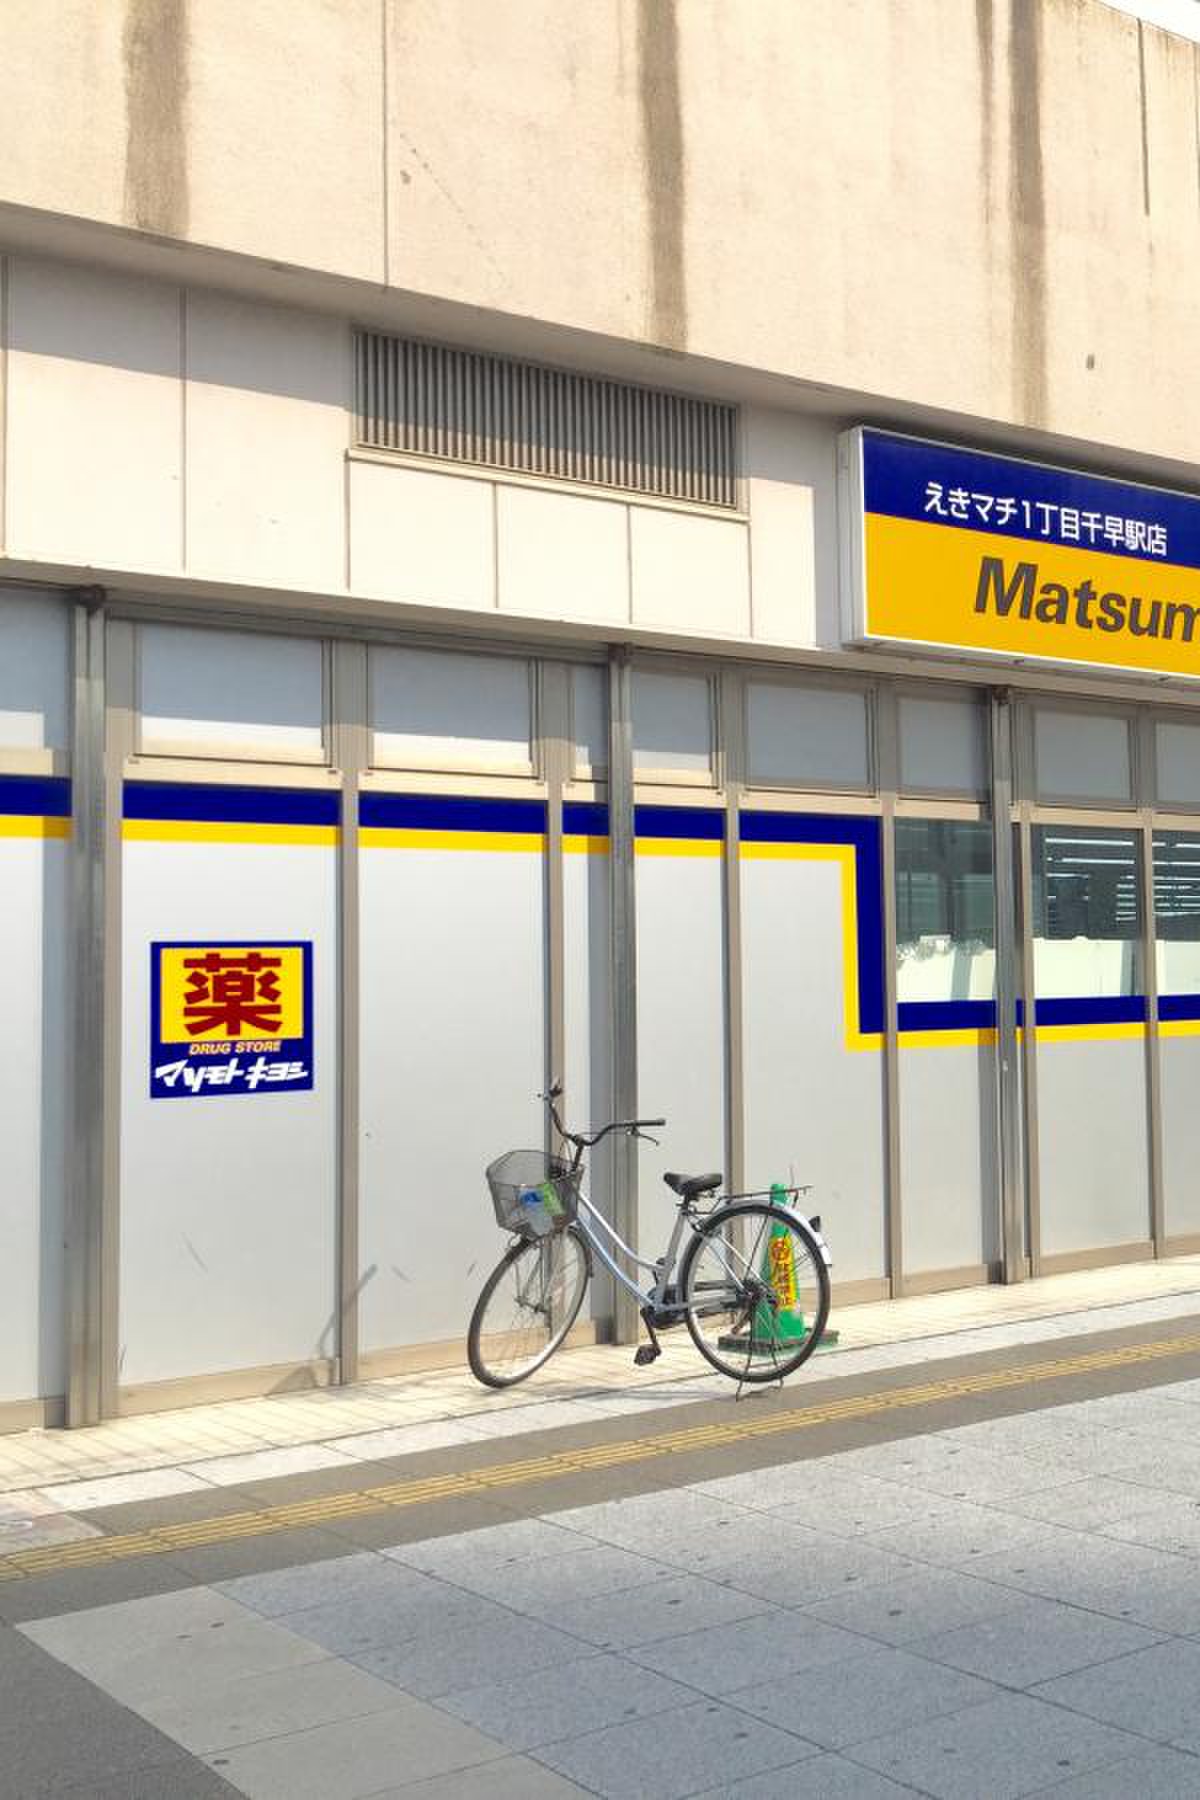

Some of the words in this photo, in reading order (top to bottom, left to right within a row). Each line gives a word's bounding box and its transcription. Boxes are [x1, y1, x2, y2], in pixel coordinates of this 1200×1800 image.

[924, 481, 1168, 557] えきマチ1丁目千早駅店
[183, 952, 282, 1036] 薬
[155, 1056, 309, 1093] マツモトキヨシ
[189, 1042, 231, 1056] DRUG
[235, 1039, 283, 1053] STORE
